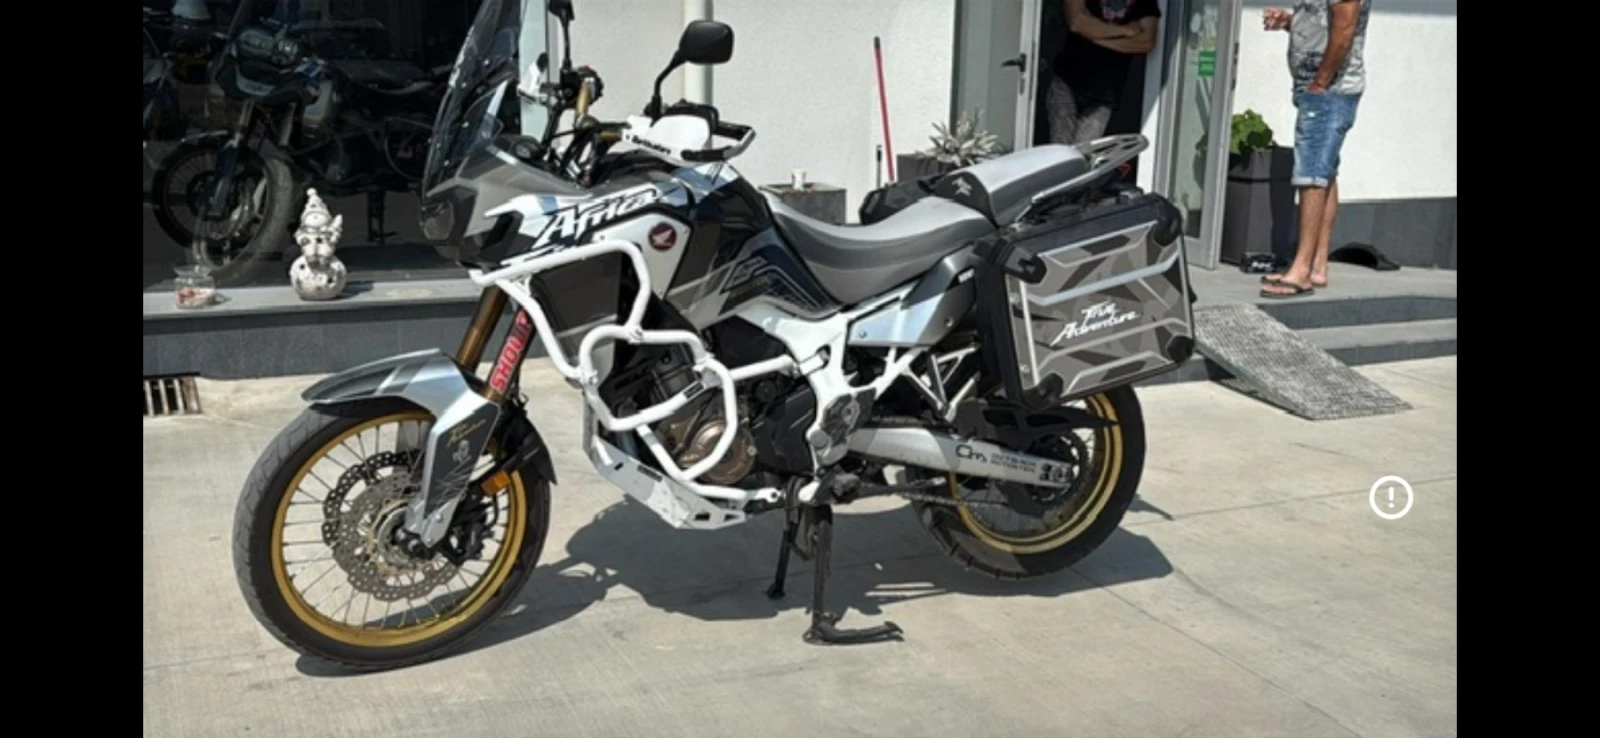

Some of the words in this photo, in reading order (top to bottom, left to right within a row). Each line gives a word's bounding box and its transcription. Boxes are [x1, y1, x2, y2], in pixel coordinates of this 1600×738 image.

[531, 189, 657, 249] Africa
[1049, 310, 1141, 347] Adventure
[1081, 298, 1118, 327] True
